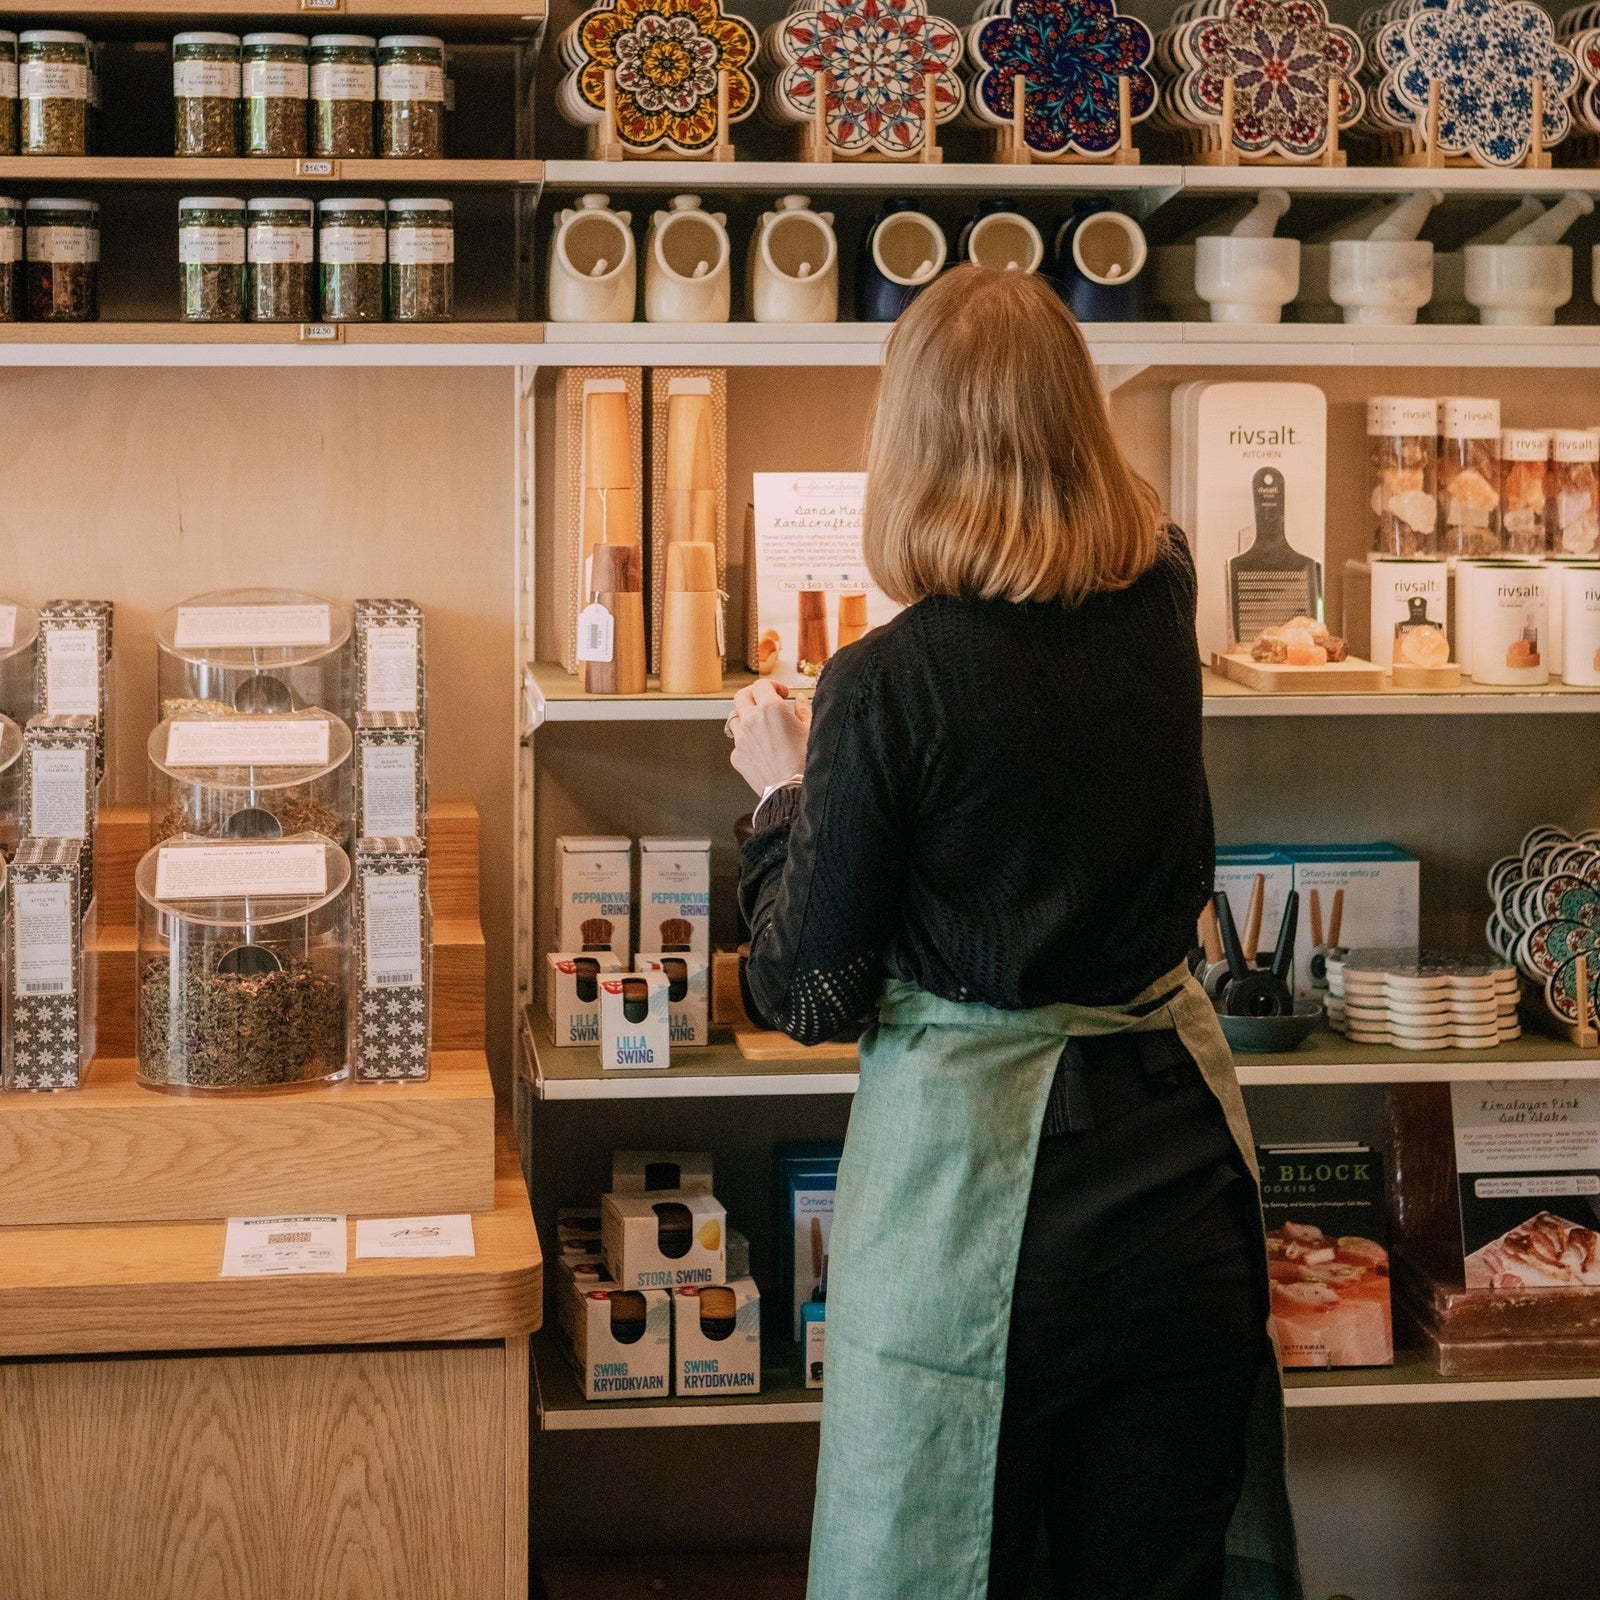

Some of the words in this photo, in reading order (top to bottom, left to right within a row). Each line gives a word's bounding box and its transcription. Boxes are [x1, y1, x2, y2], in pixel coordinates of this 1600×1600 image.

[1402, 409, 1431, 420] rivsalt
[1463, 410, 1493, 421] rivsalt
[1229, 425, 1296, 446] rivsalt
[1558, 438, 1594, 450] rivsalt
[1242, 450, 1281, 459] KITCHEN
[773, 518, 862, 532] Handcrafted
[807, 581, 834, 590] $69.95
[1395, 579, 1436, 593] rivsalt
[1498, 584, 1540, 598] rivsalt
[570, 1013, 599, 1028] LILLA
[570, 1027, 599, 1041] SWIN
[616, 1035, 647, 1050] LILLA
[616, 1049, 654, 1065] SWING
[1480, 1099, 1548, 1114] Himalayan
[1551, 1098, 1579, 1110] Pink
[1498, 1112, 1526, 1123] Salt
[1529, 1111, 1569, 1122] Slabs
[1279, 1164, 1371, 1181] BLOCK
[637, 1271, 672, 1287] STORA
[676, 1267, 712, 1284] SWING
[593, 1362, 628, 1378] SWING
[683, 1359, 718, 1374] SWING
[593, 1375, 664, 1393] KRYDDKVARN
[684, 1372, 755, 1390] KRYDDKVARN
